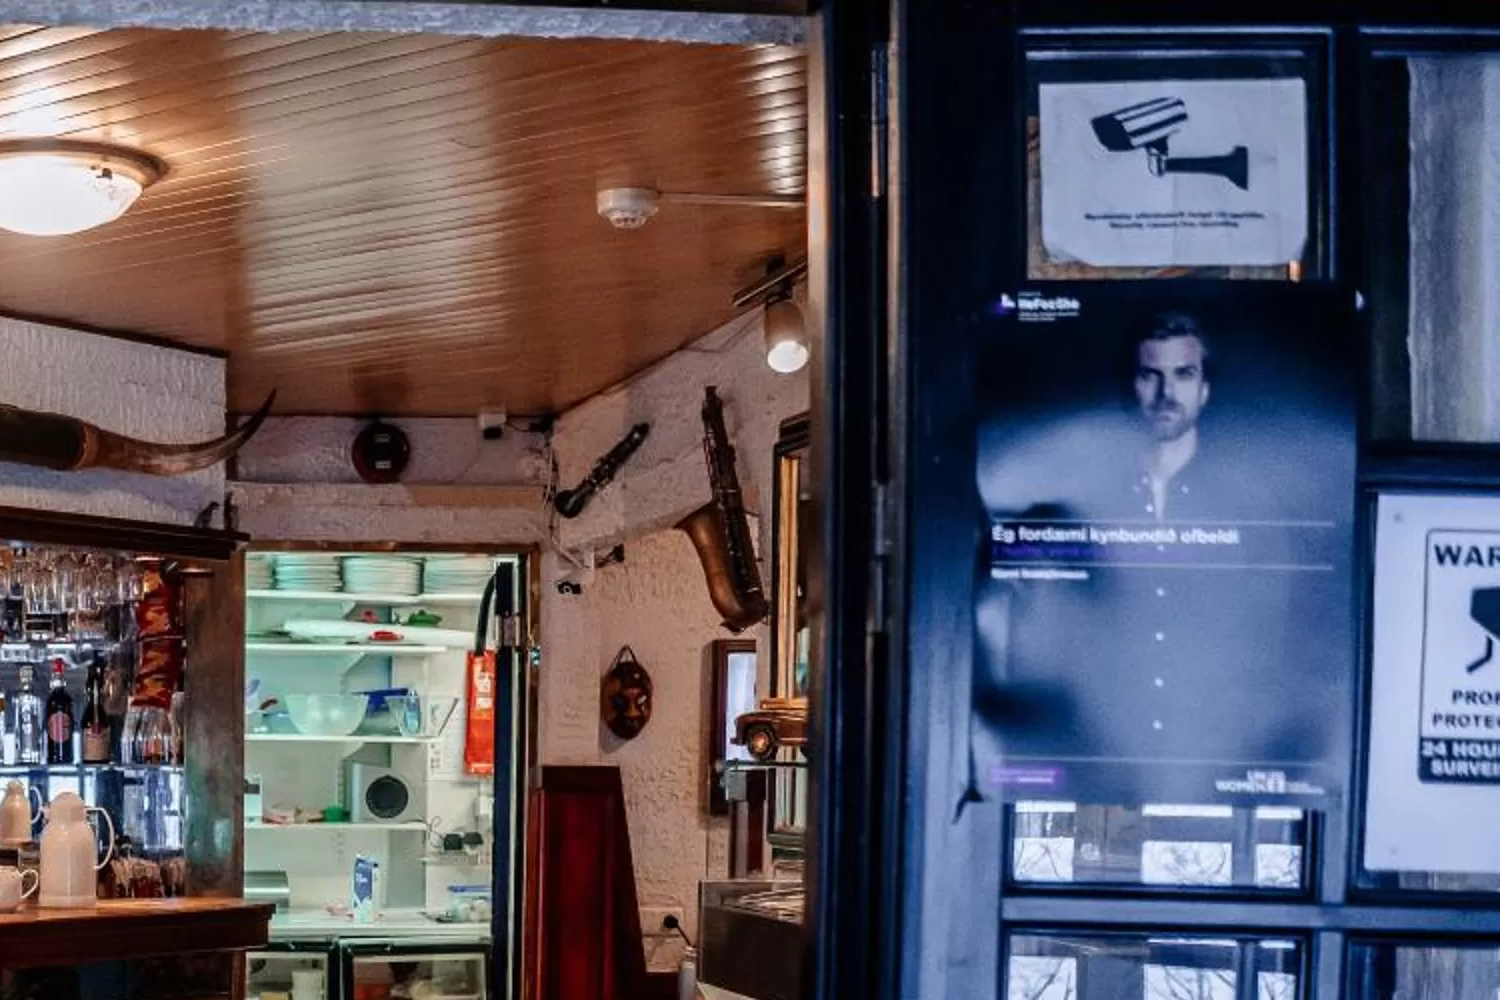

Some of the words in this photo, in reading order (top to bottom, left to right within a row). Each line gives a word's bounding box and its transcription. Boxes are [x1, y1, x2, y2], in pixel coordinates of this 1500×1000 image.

[1434, 544, 1500, 567] WAR
[1432, 712, 1500, 729] PROTE
[1430, 759, 1500, 777] SURVEI
